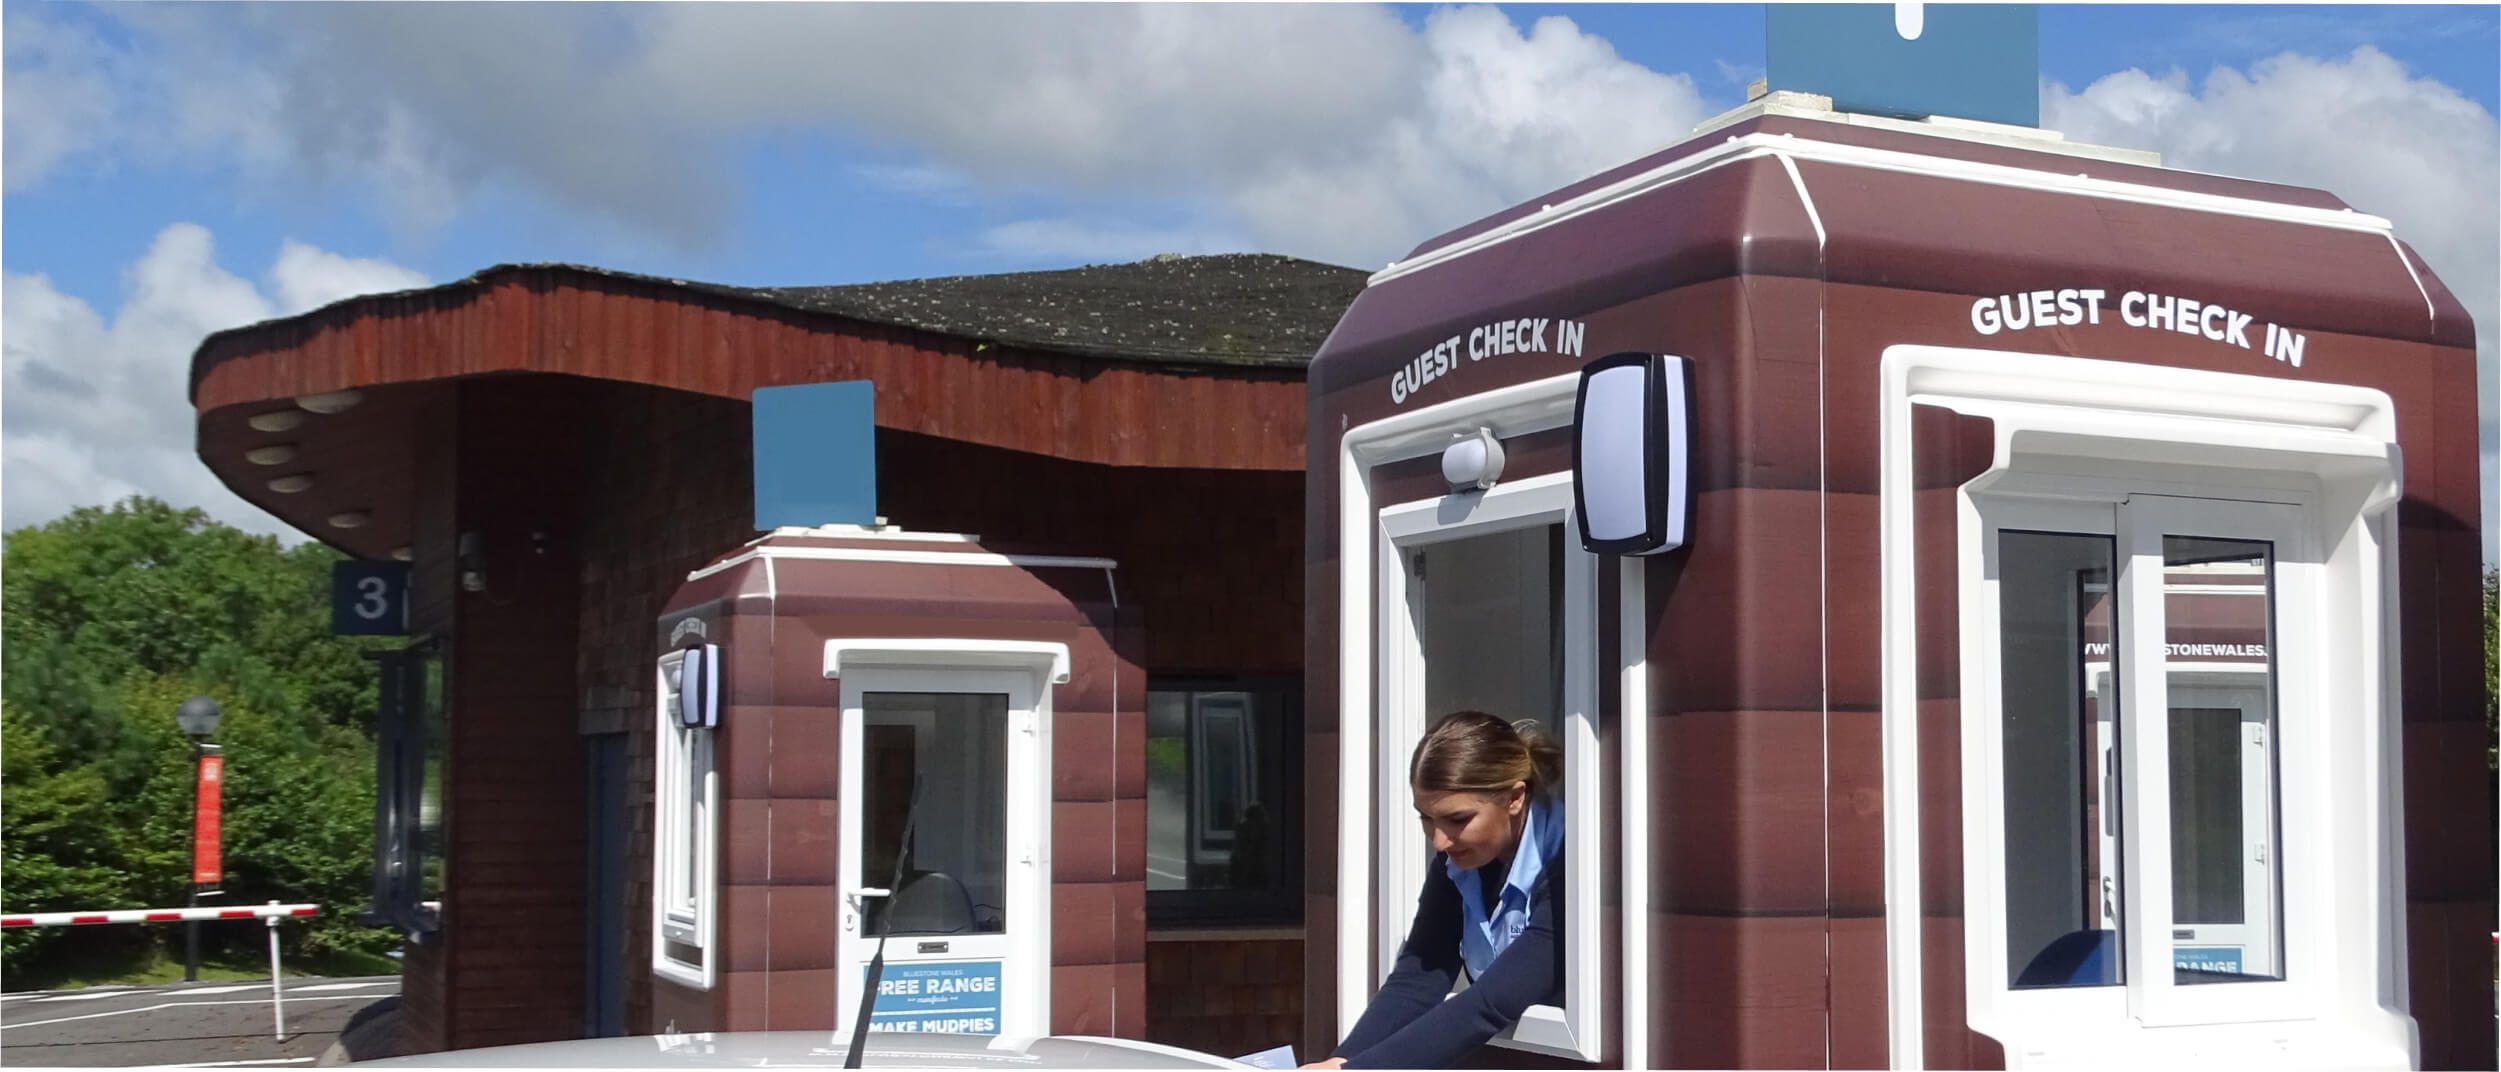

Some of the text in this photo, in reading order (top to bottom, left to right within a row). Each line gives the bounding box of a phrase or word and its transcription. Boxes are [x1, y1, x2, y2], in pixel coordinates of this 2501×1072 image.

[1970, 289, 2306, 368] GUEST CHECK IN
[1391, 318, 1585, 404] GUEST CHECK IN
[355, 576, 387, 619] 3
[878, 977, 995, 996] REE RANGE
[922, 1018, 994, 1033] MUDPIES
